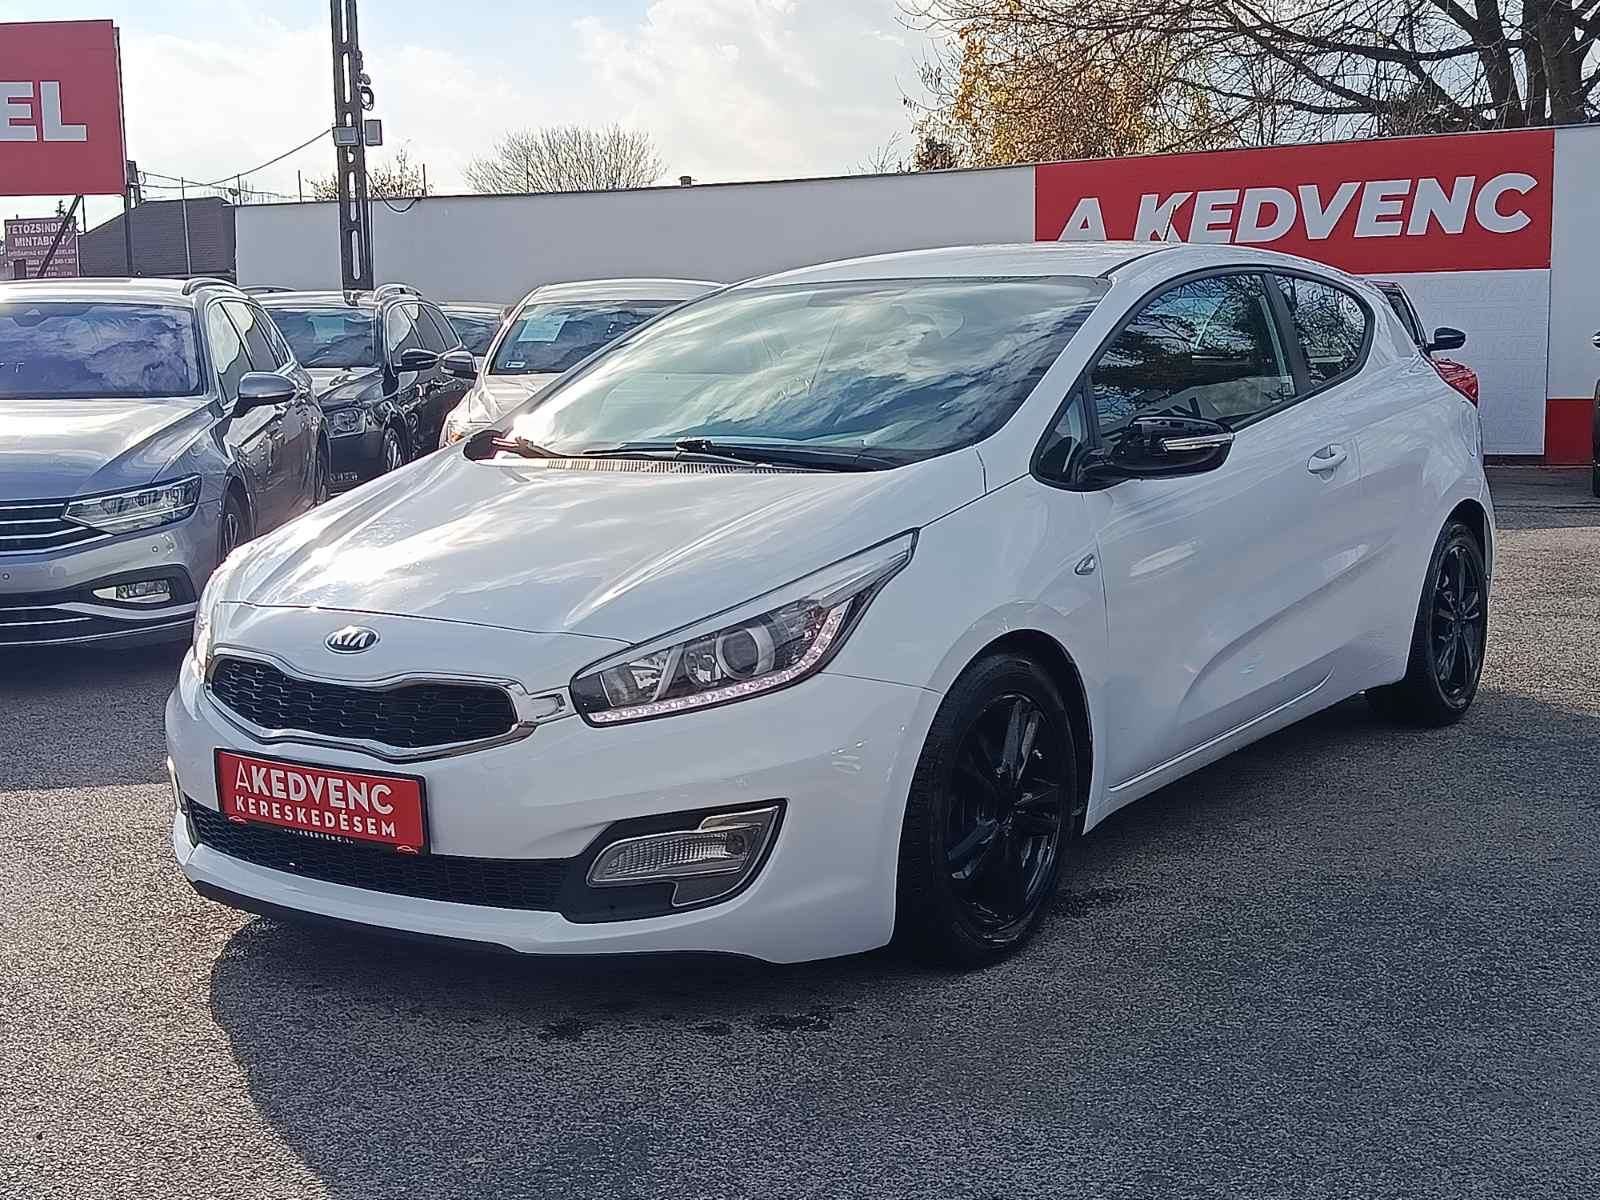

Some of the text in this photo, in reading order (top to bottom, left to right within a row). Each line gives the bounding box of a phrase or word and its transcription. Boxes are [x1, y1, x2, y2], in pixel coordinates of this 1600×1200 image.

[0, 81, 87, 141] EL
[1058, 172, 1538, 244] A KEDVENC
[329, 629, 370, 648] KIA
[235, 795, 396, 838] KERESKEDÉSEM
